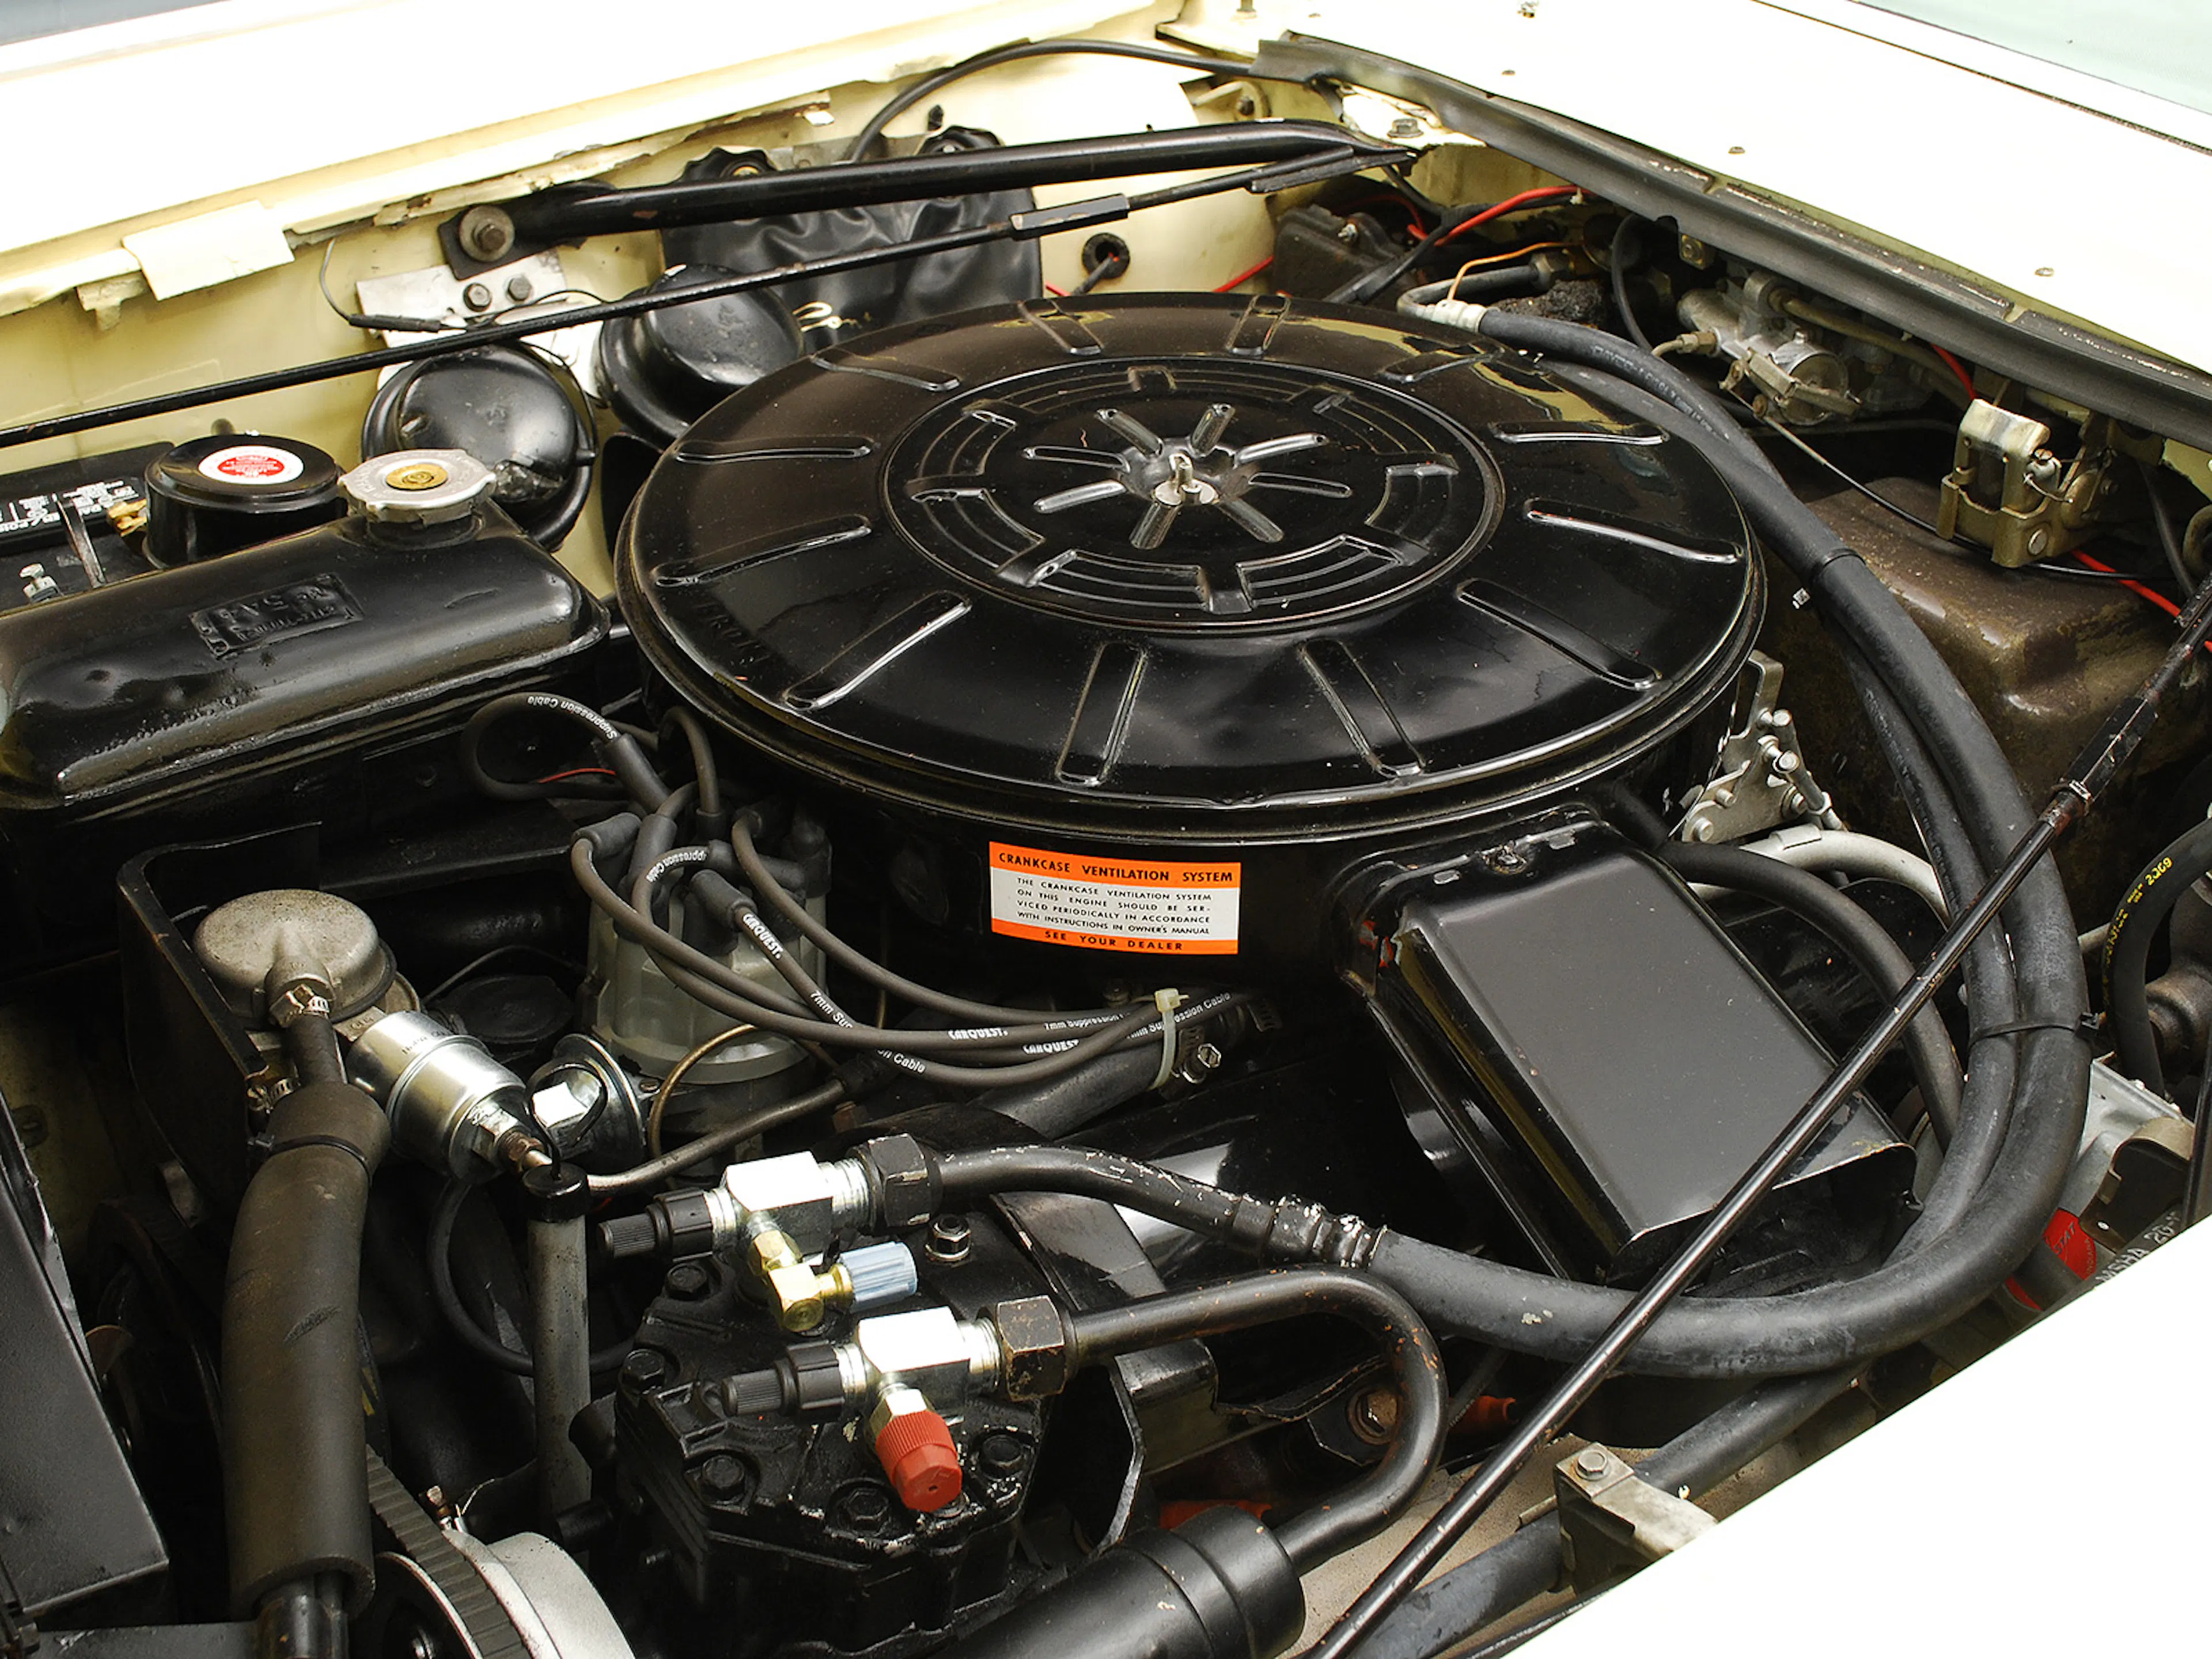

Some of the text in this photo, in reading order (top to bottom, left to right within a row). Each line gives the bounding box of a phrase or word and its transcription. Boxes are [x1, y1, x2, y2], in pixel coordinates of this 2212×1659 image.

[527, 696, 618, 740] Suppression Cable
[662, 850, 707, 867] ppression
[999, 853, 1232, 882] CRANKCASE VENTILATION SYSTEM
[1017, 877, 1033, 887] THE
[1041, 881, 1099, 895] CRANKCASE
[1107, 890, 1170, 900] VENTILATION
[1017, 900, 1048, 910] VICED
[1053, 907, 1119, 919] PERIODICALLY
[1142, 915, 1210, 923] ACCORDANCE
[1039, 893, 1059, 901] THIS
[1070, 897, 1107, 907] ENGINE
[1118, 902, 1158, 911] SHOULD
[1017, 911, 1039, 919] WITH
[1044, 916, 1108, 929] INSTRUCTIONS
[1128, 925, 1167, 933] OWNER'S
[1045, 931, 1183, 950] SEE YOUR DEALER
[810, 990, 834, 1014] 7mm
[1203, 992, 1231, 1009] Cable
[893, 1052, 926, 1074] Cable
